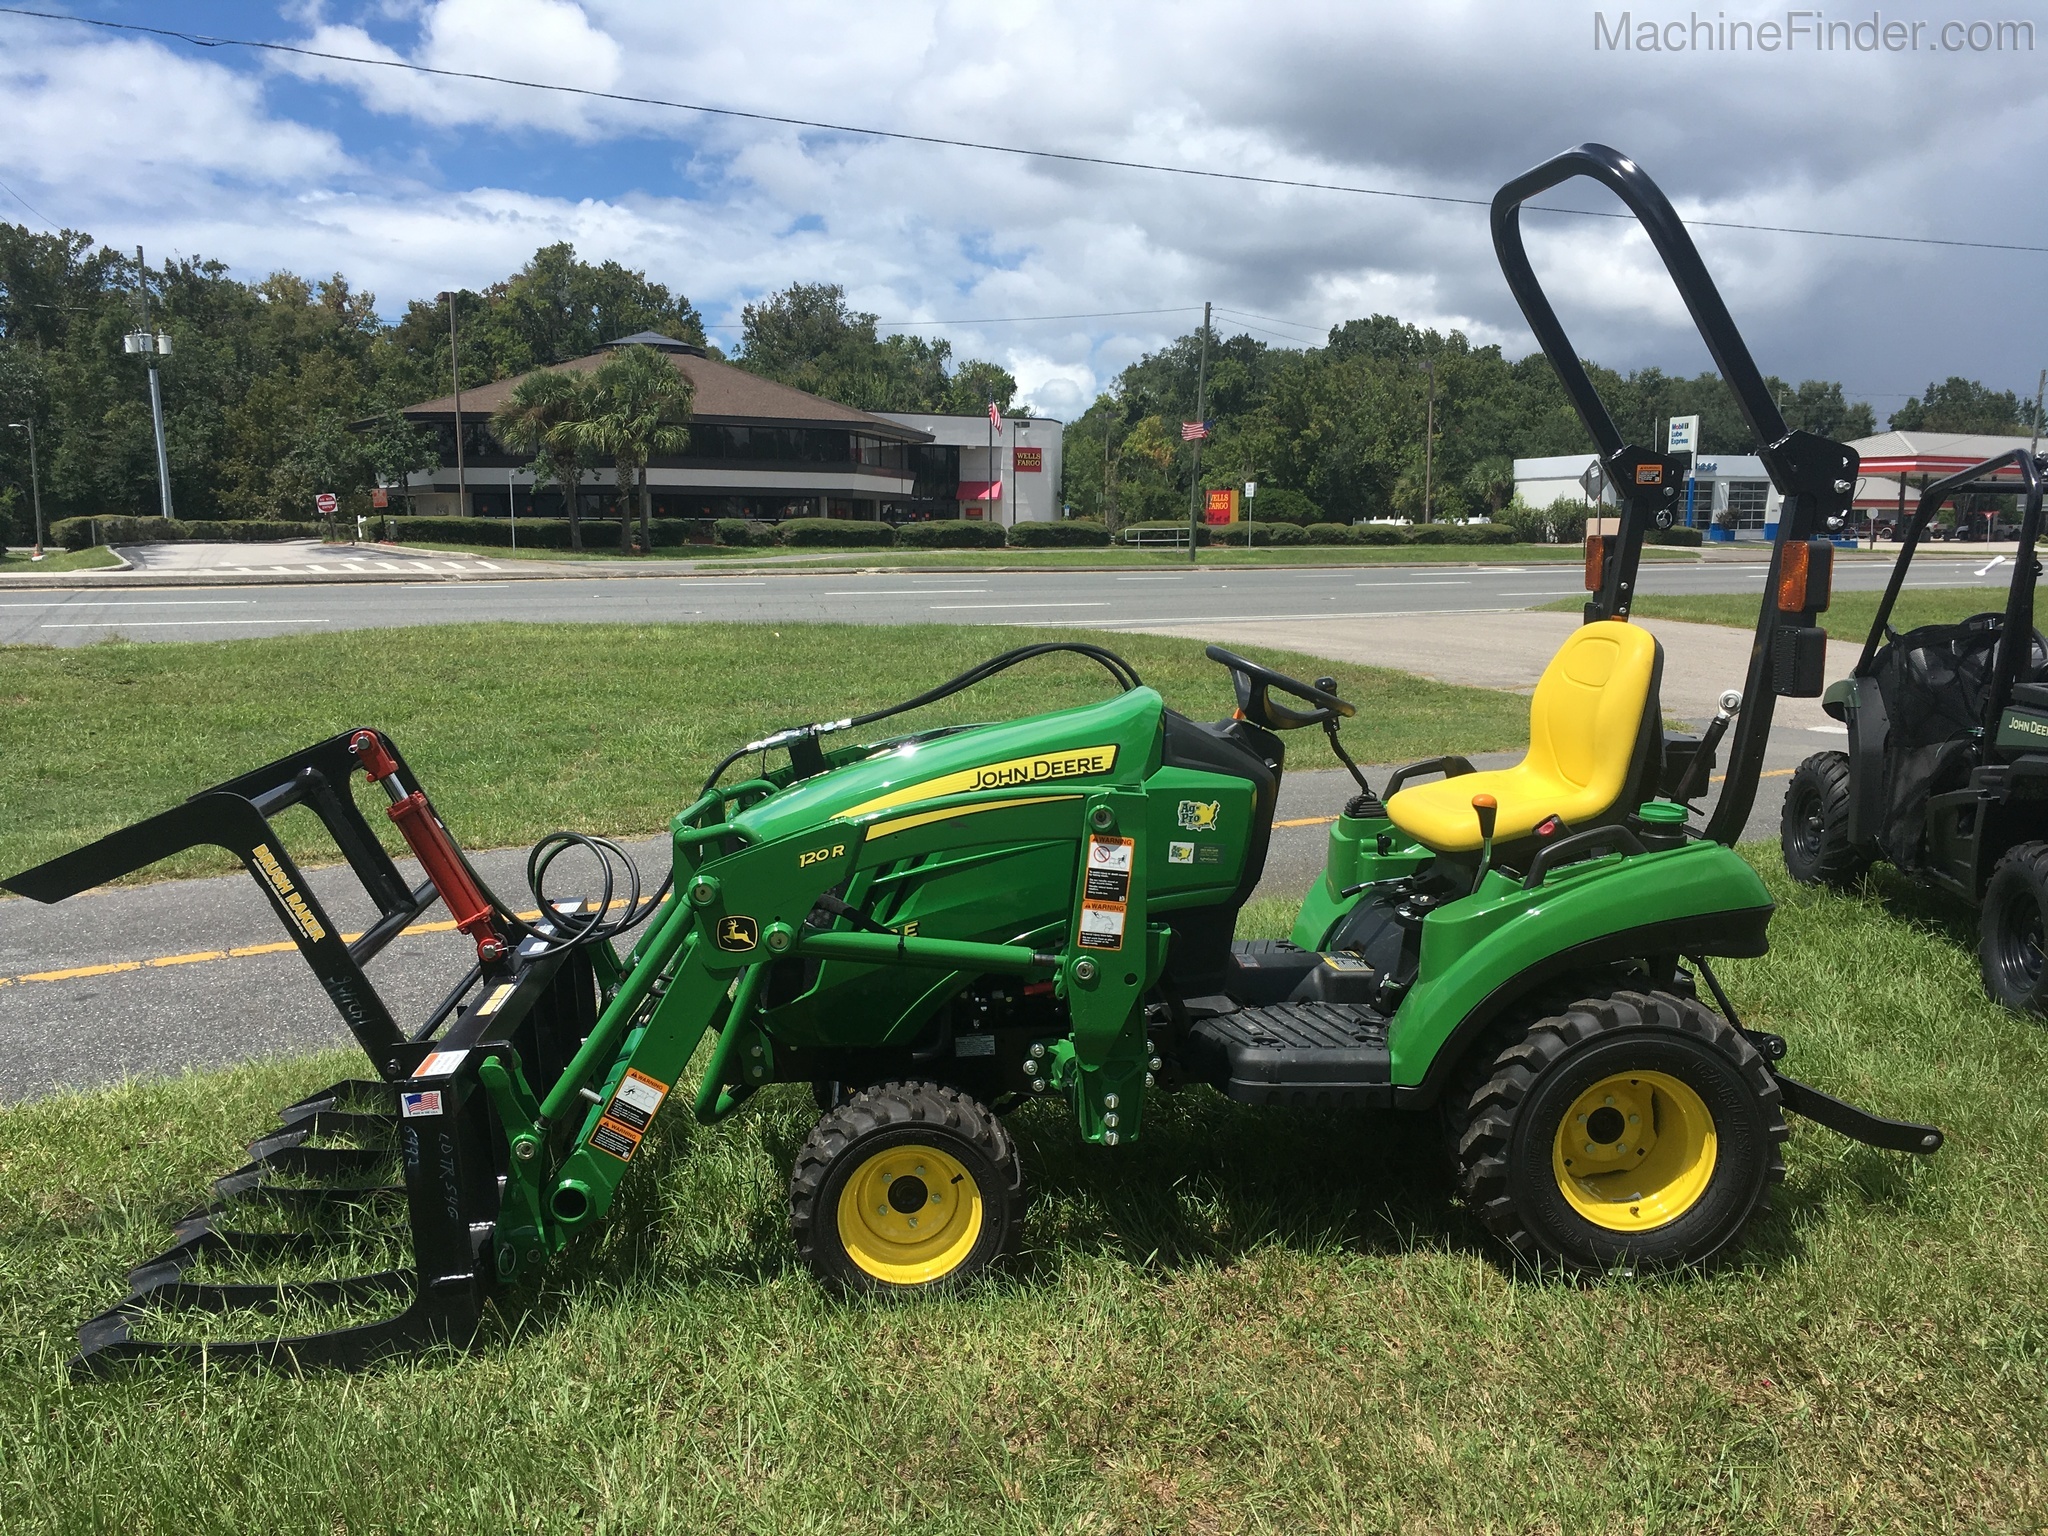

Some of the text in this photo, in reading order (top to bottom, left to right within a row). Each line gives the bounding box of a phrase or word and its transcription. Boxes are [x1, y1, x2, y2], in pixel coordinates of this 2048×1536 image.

[2008, 716, 2030, 732] JOHN
[969, 756, 1104, 790] JOHN DEERE
[1180, 813, 1200, 823] Pro
[1099, 836, 1132, 847] WARNING
[799, 844, 845, 868] 120 R
[252, 843, 295, 895] BRUSH
[285, 891, 326, 943] RAKER
[1091, 903, 1125, 912] WARNING
[637, 1075, 663, 1091] WARNING
[611, 1124, 637, 1140] WARNING
